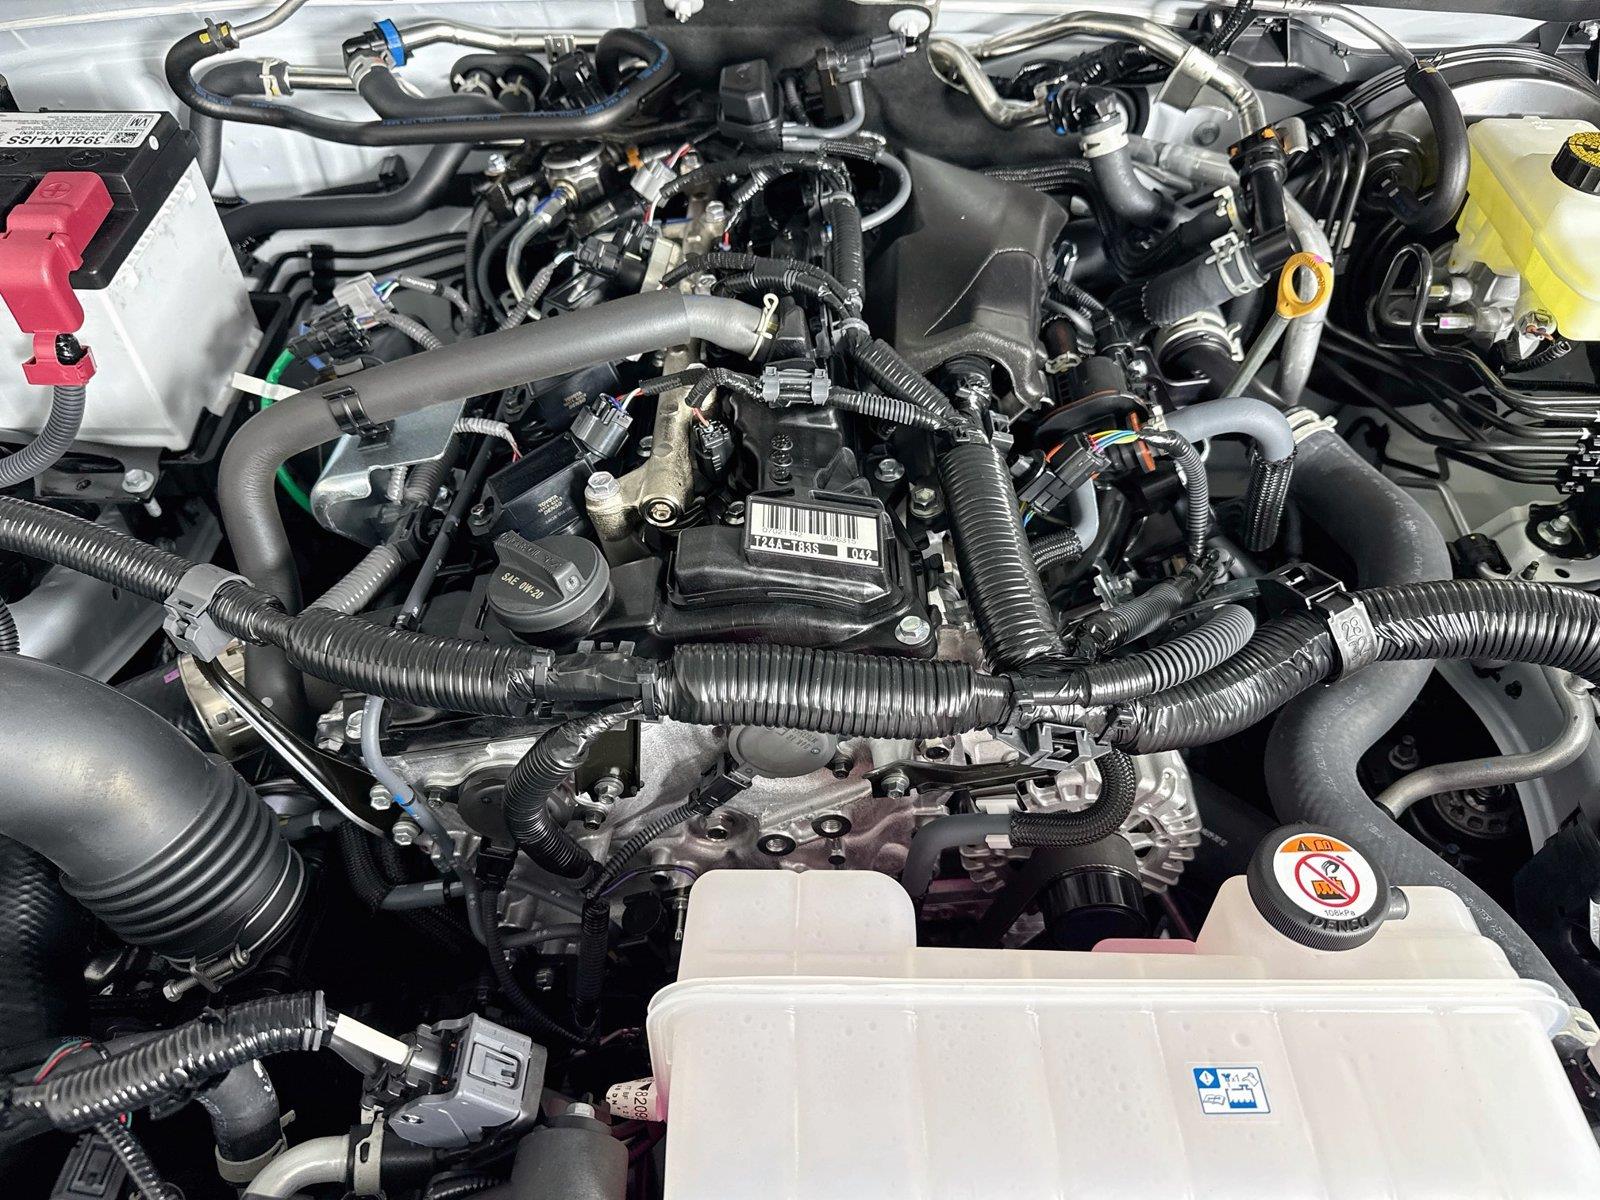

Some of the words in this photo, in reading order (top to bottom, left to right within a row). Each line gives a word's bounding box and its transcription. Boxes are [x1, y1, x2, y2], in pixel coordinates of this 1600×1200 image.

[129, 118, 148, 127] VM
[7, 136, 105, 145] 395LN4-ISS
[754, 535, 820, 555] T24A-T83S
[851, 549, 873, 561] 042
[501, 572, 519, 586] SAE
[518, 580, 545, 600] 0W-20
[1341, 615, 1363, 642] 28
[1308, 915, 1370, 933] DENSO
